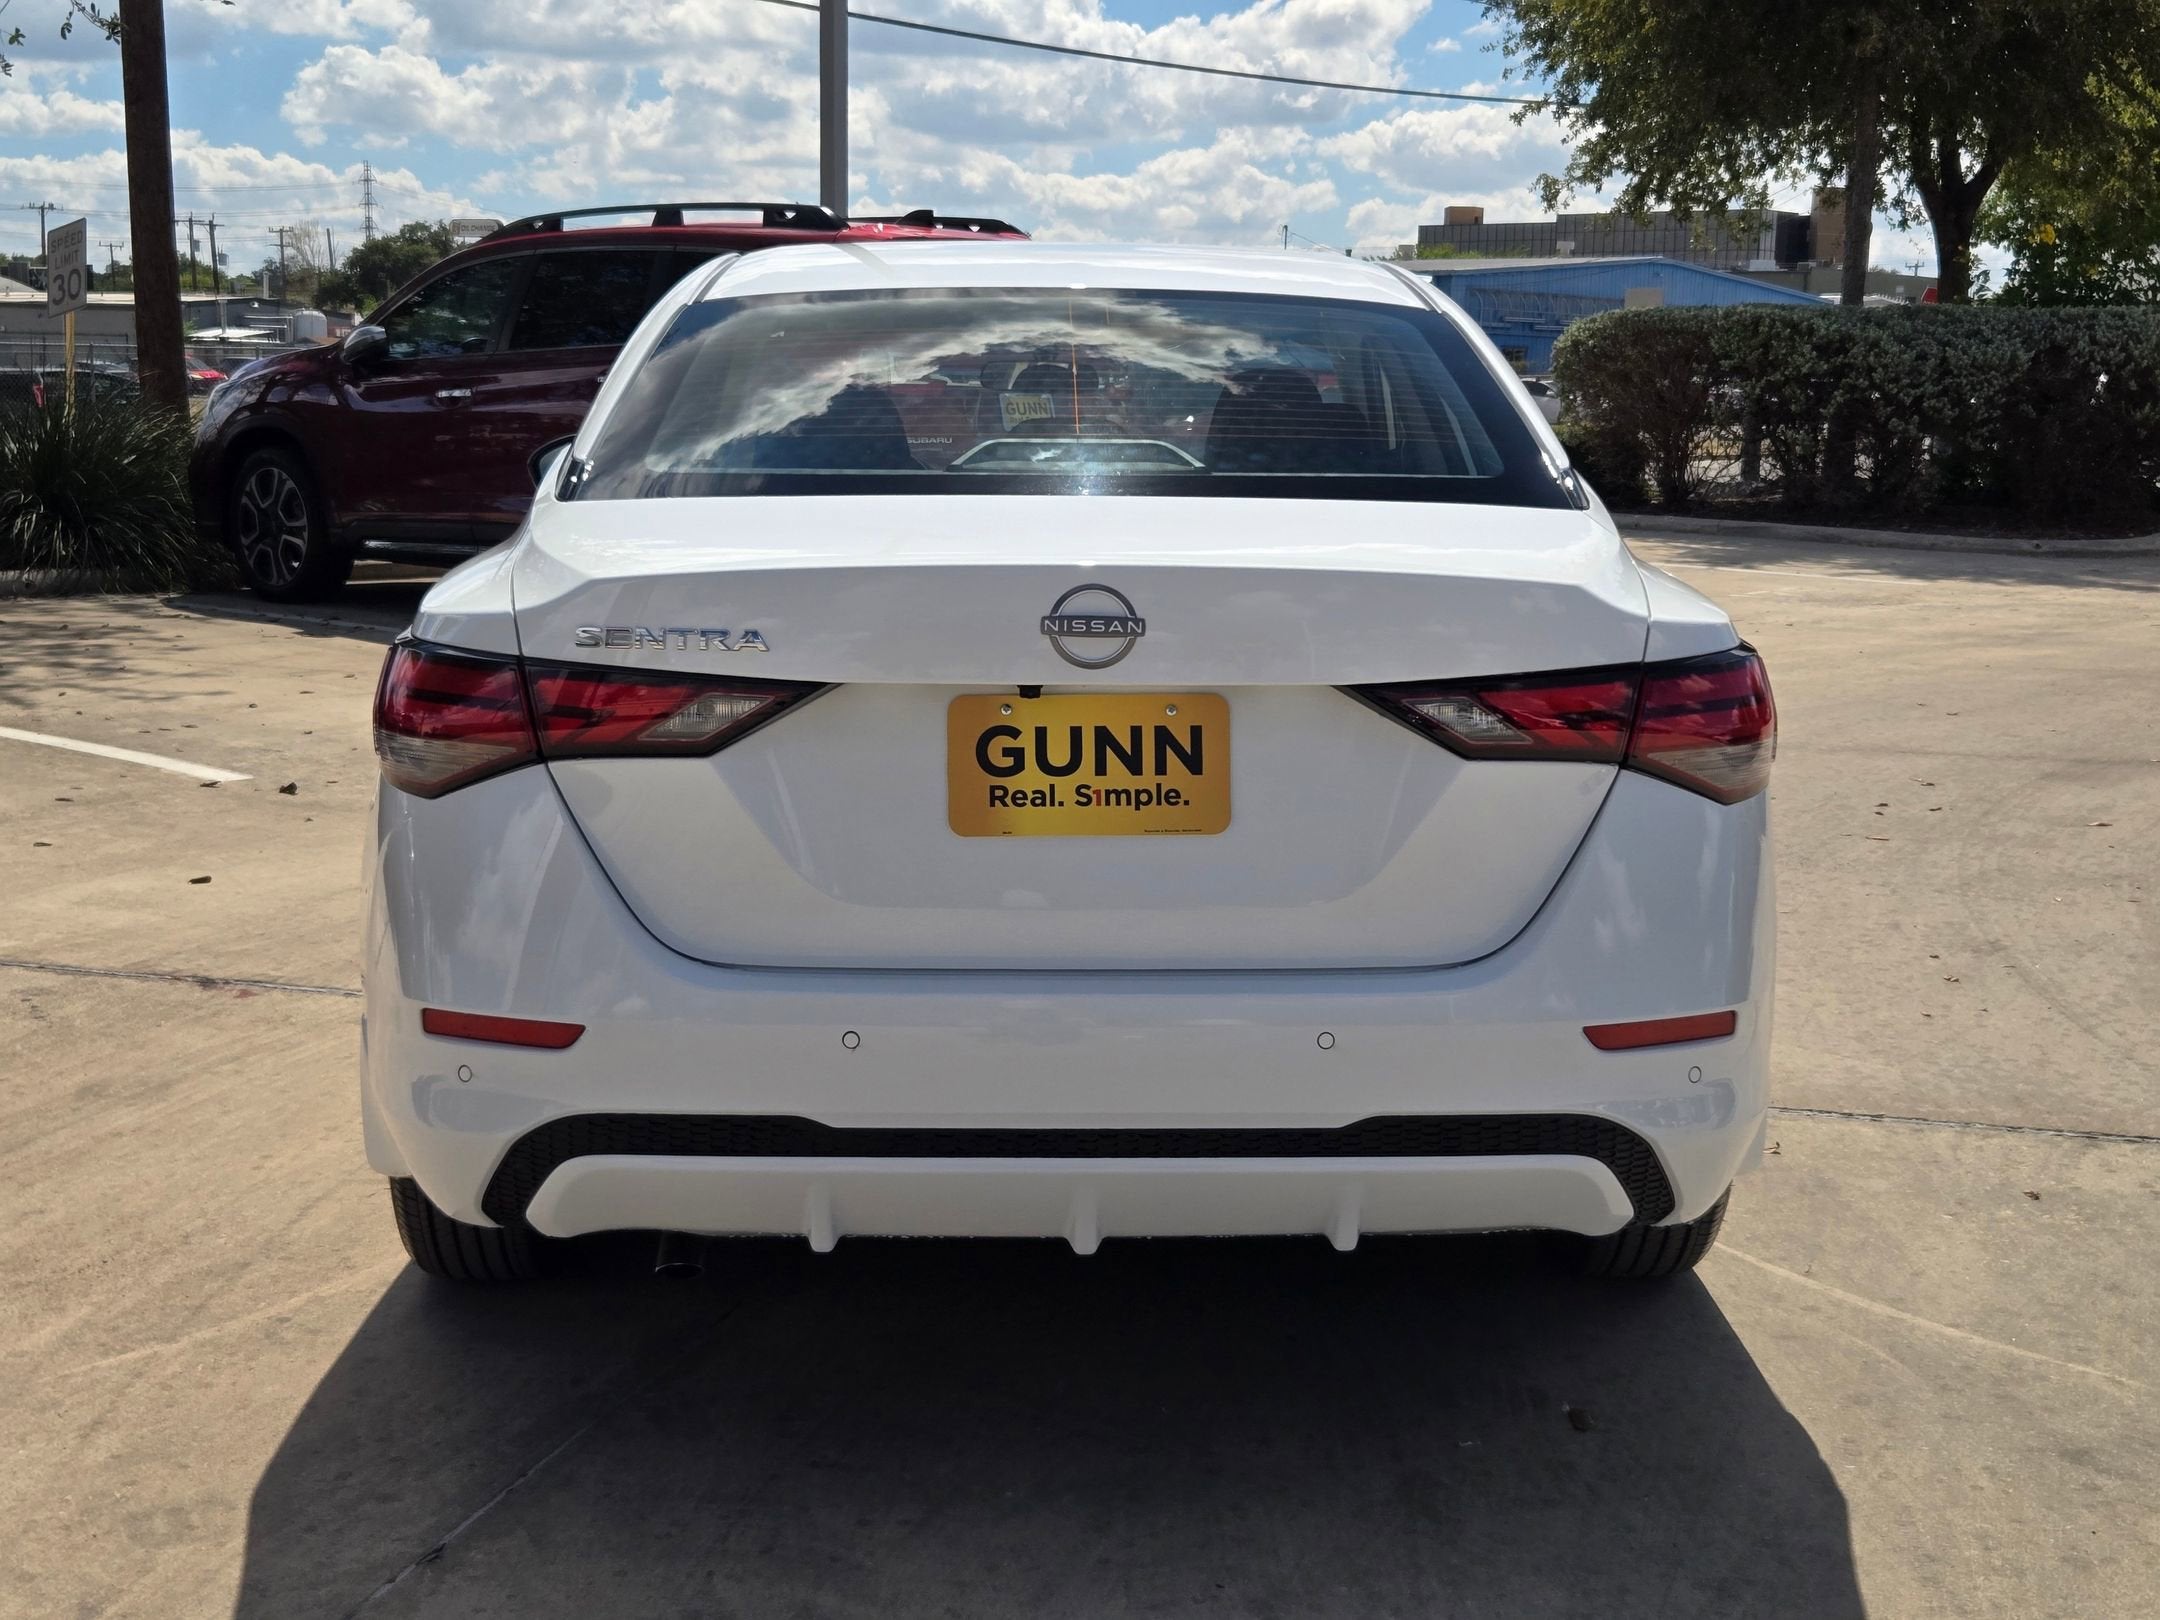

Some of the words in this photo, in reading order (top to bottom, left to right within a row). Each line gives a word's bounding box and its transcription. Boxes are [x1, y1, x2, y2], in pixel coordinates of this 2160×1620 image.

[51, 230, 83, 254] SPEED
[54, 250, 79, 269] LIMIT
[52, 268, 81, 305] 30
[1006, 402, 1048, 416] GUNN
[575, 625, 769, 651] SENTRA
[1044, 619, 1142, 633] NISSAN
[975, 724, 1203, 778] GUNN
[989, 783, 1064, 807] Real.
